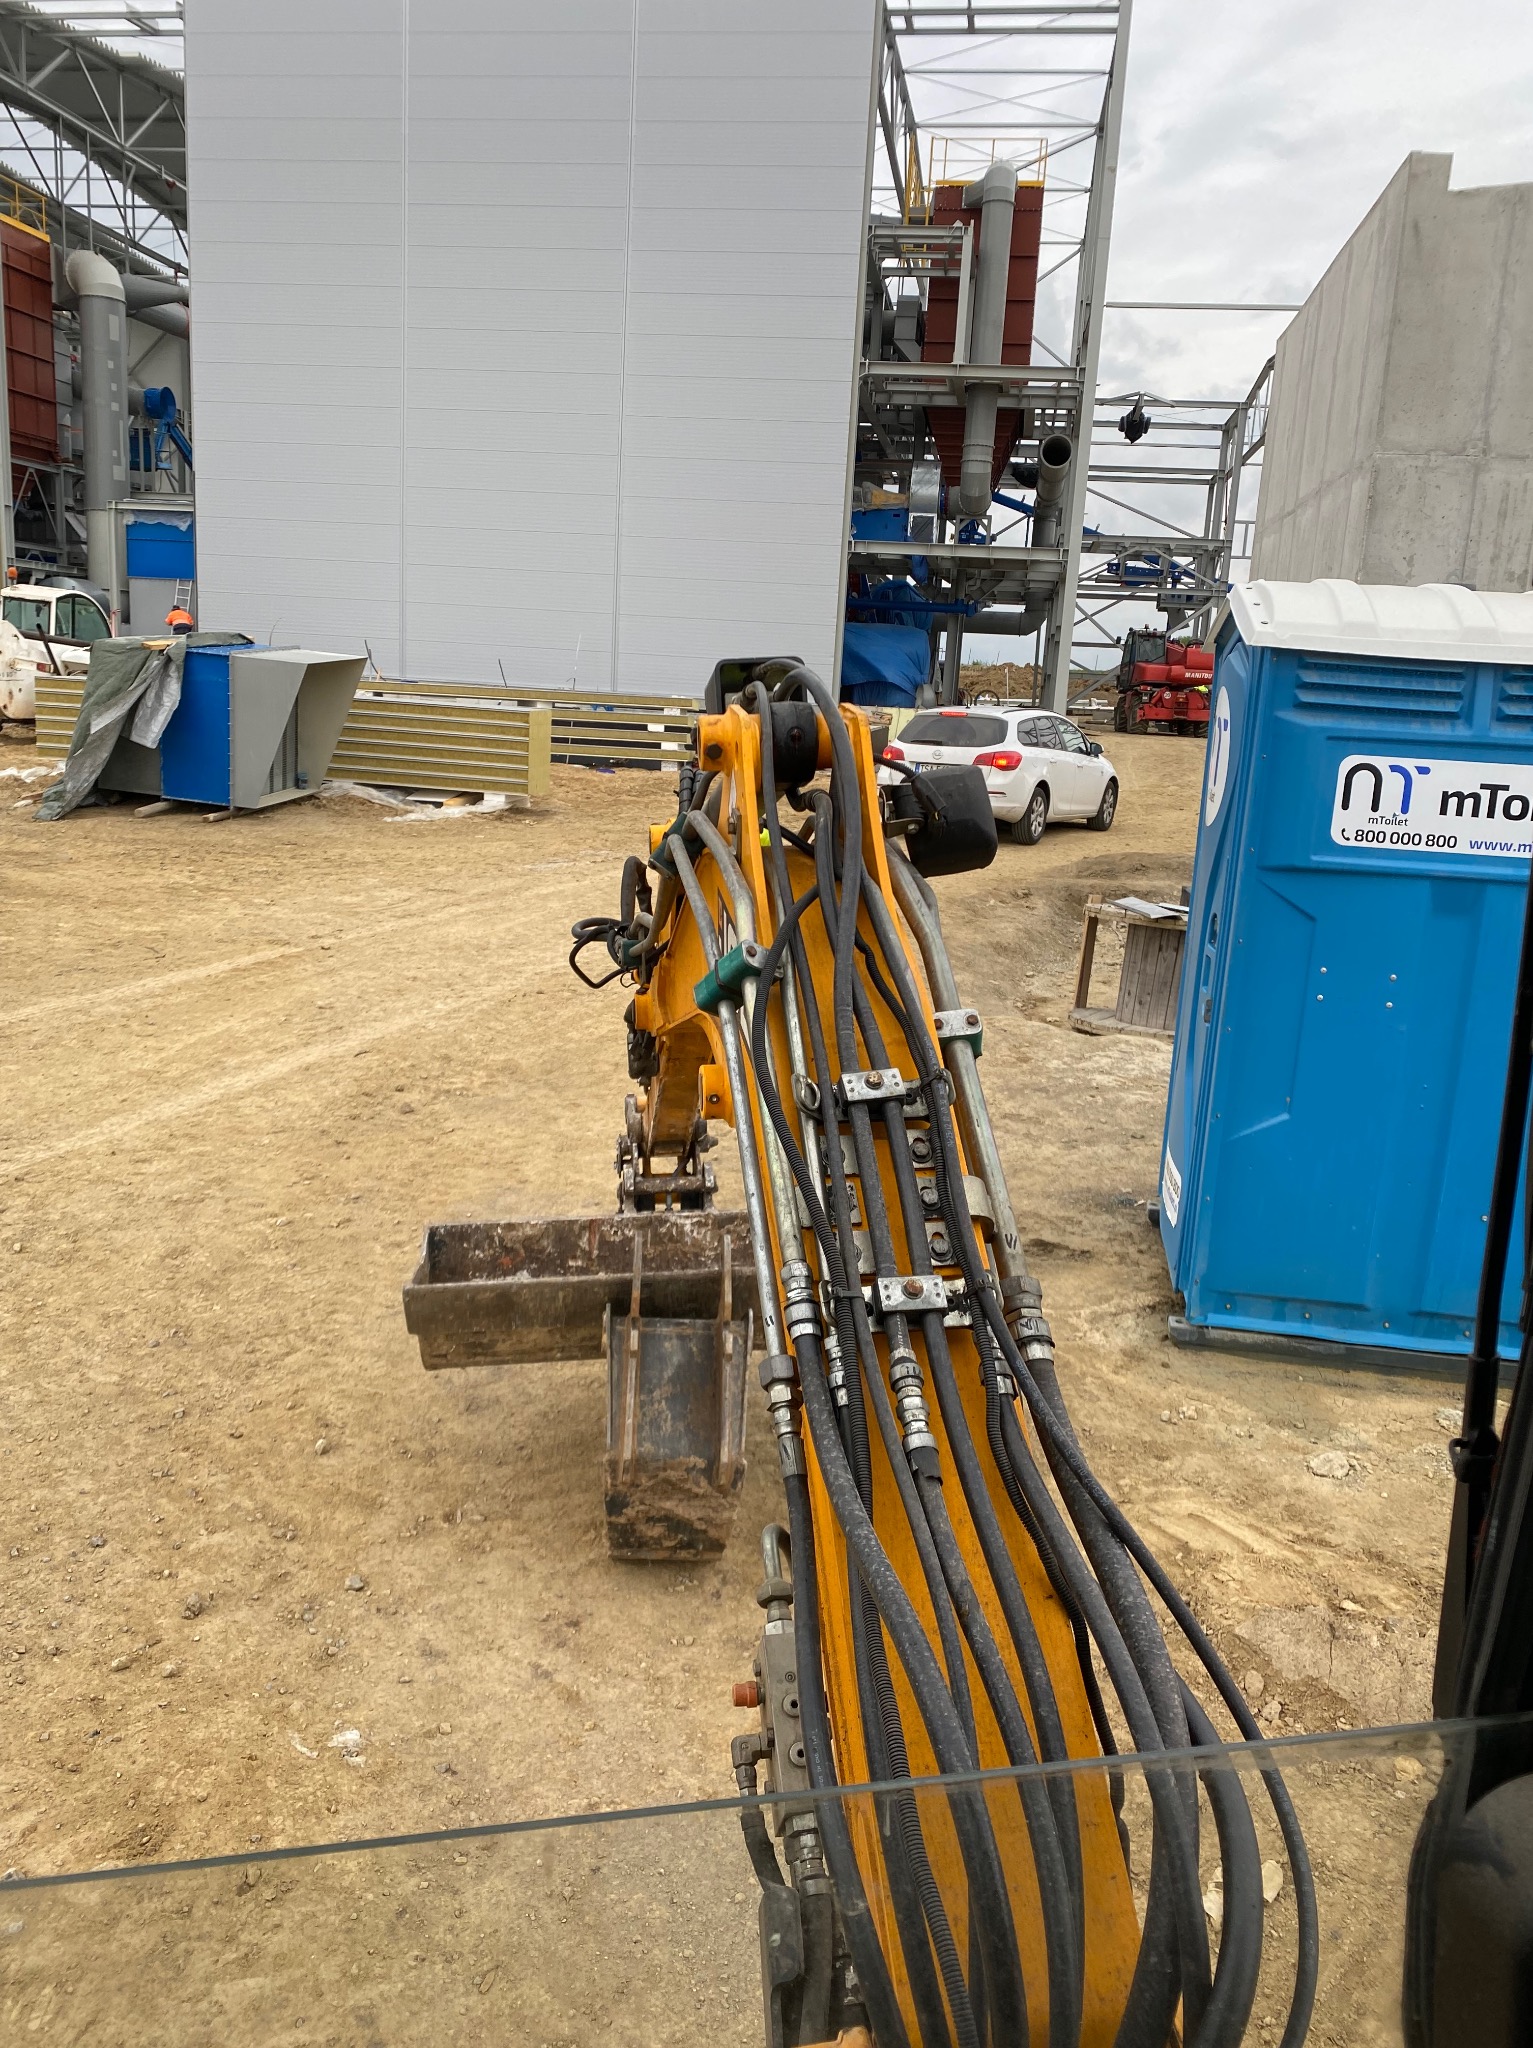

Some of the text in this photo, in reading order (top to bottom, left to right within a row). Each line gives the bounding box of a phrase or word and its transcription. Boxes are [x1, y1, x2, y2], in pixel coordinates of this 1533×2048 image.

[1439, 783, 1533, 821] mTo
[1368, 815, 1409, 827] mToilet
[1354, 829, 1533, 853] 800 000 800 www.m
